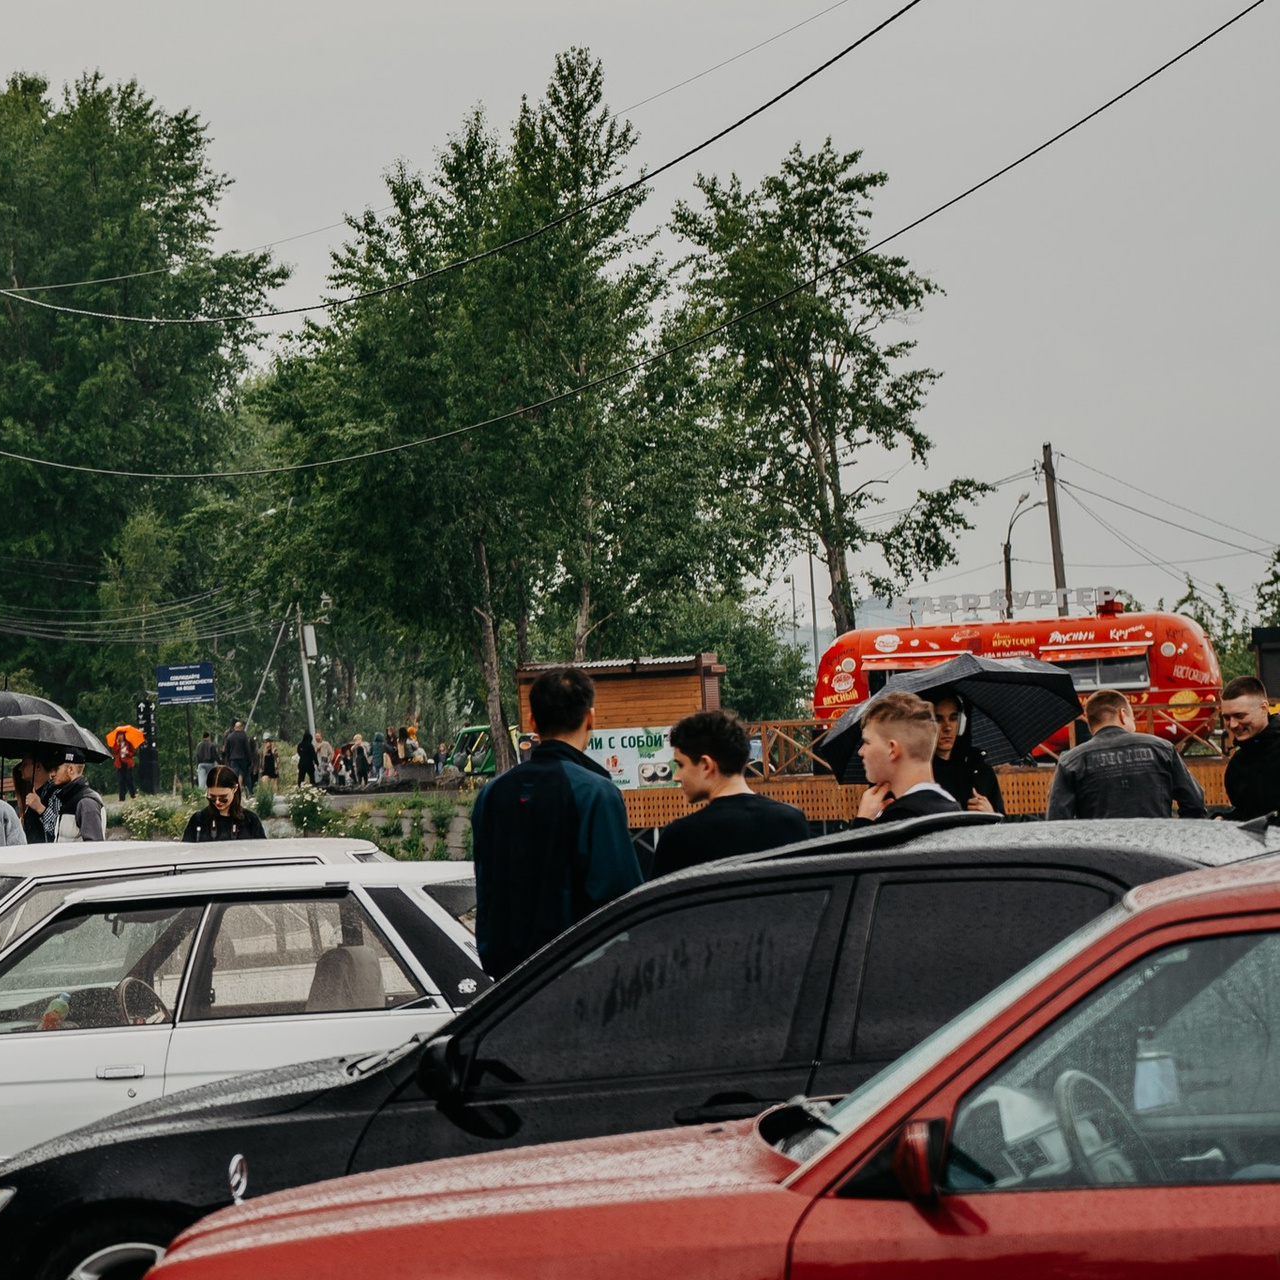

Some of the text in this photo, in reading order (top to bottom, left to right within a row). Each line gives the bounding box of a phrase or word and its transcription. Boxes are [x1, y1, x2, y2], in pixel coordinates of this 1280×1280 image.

[894, 586, 1118, 617] БАБР БУРГЕР
[992, 637, 1036, 648] ИРКУТСКИЙ
[608, 736, 616, 749] С
[621, 732, 663, 749] СОБОЙ
